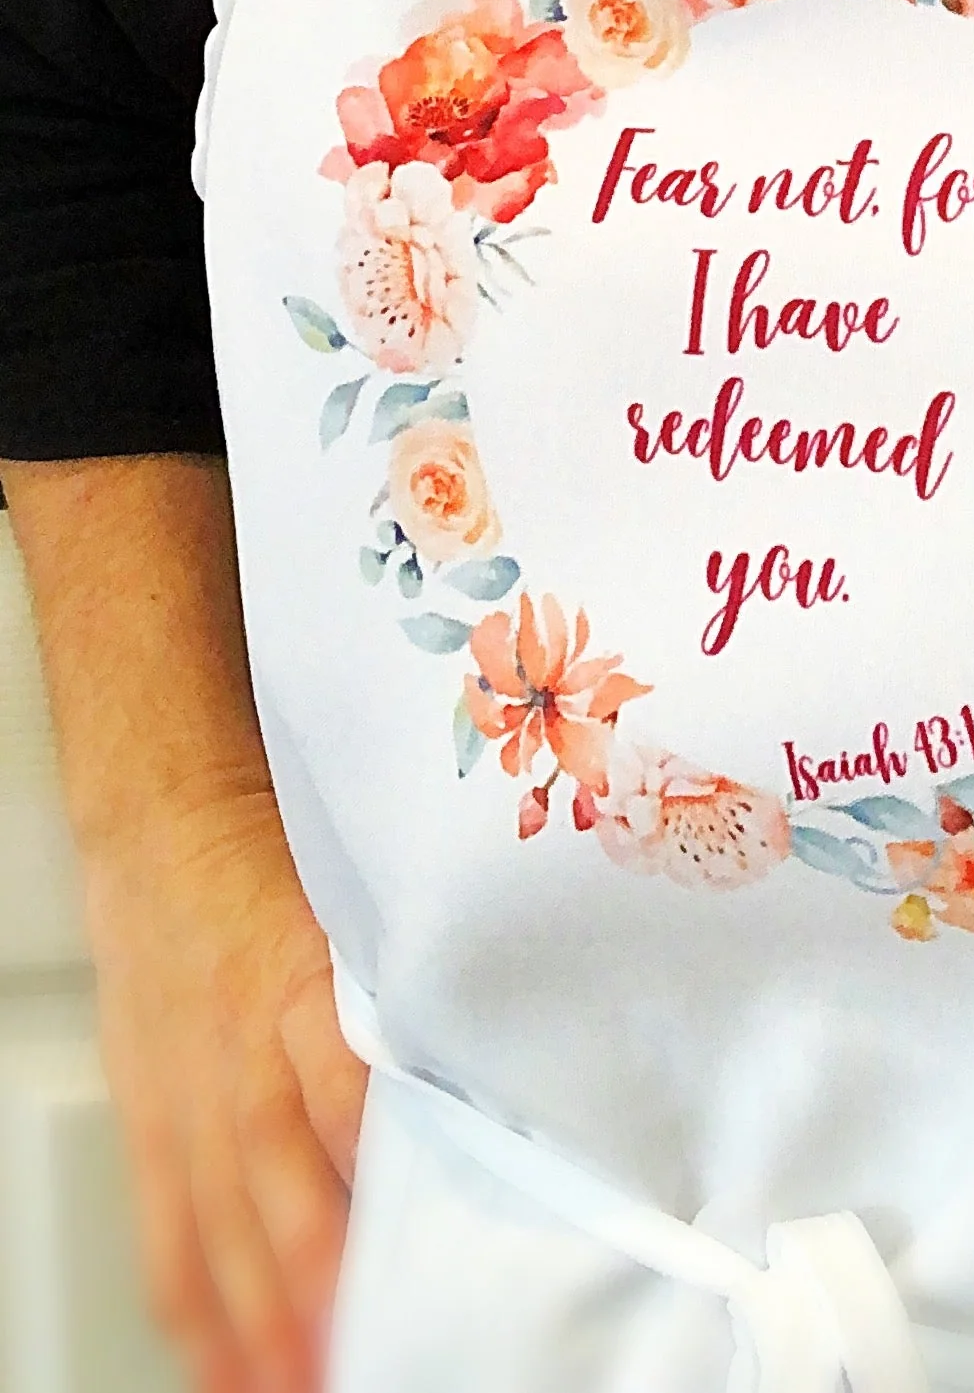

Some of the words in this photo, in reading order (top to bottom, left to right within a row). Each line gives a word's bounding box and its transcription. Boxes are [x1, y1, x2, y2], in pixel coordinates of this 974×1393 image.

[592, 127, 738, 224] Fear
[682, 248, 717, 356] I
[727, 249, 900, 355] have
[627, 376, 957, 501] redeemed
[701, 544, 849, 656] you.
[781, 721, 908, 802] Isaiah
